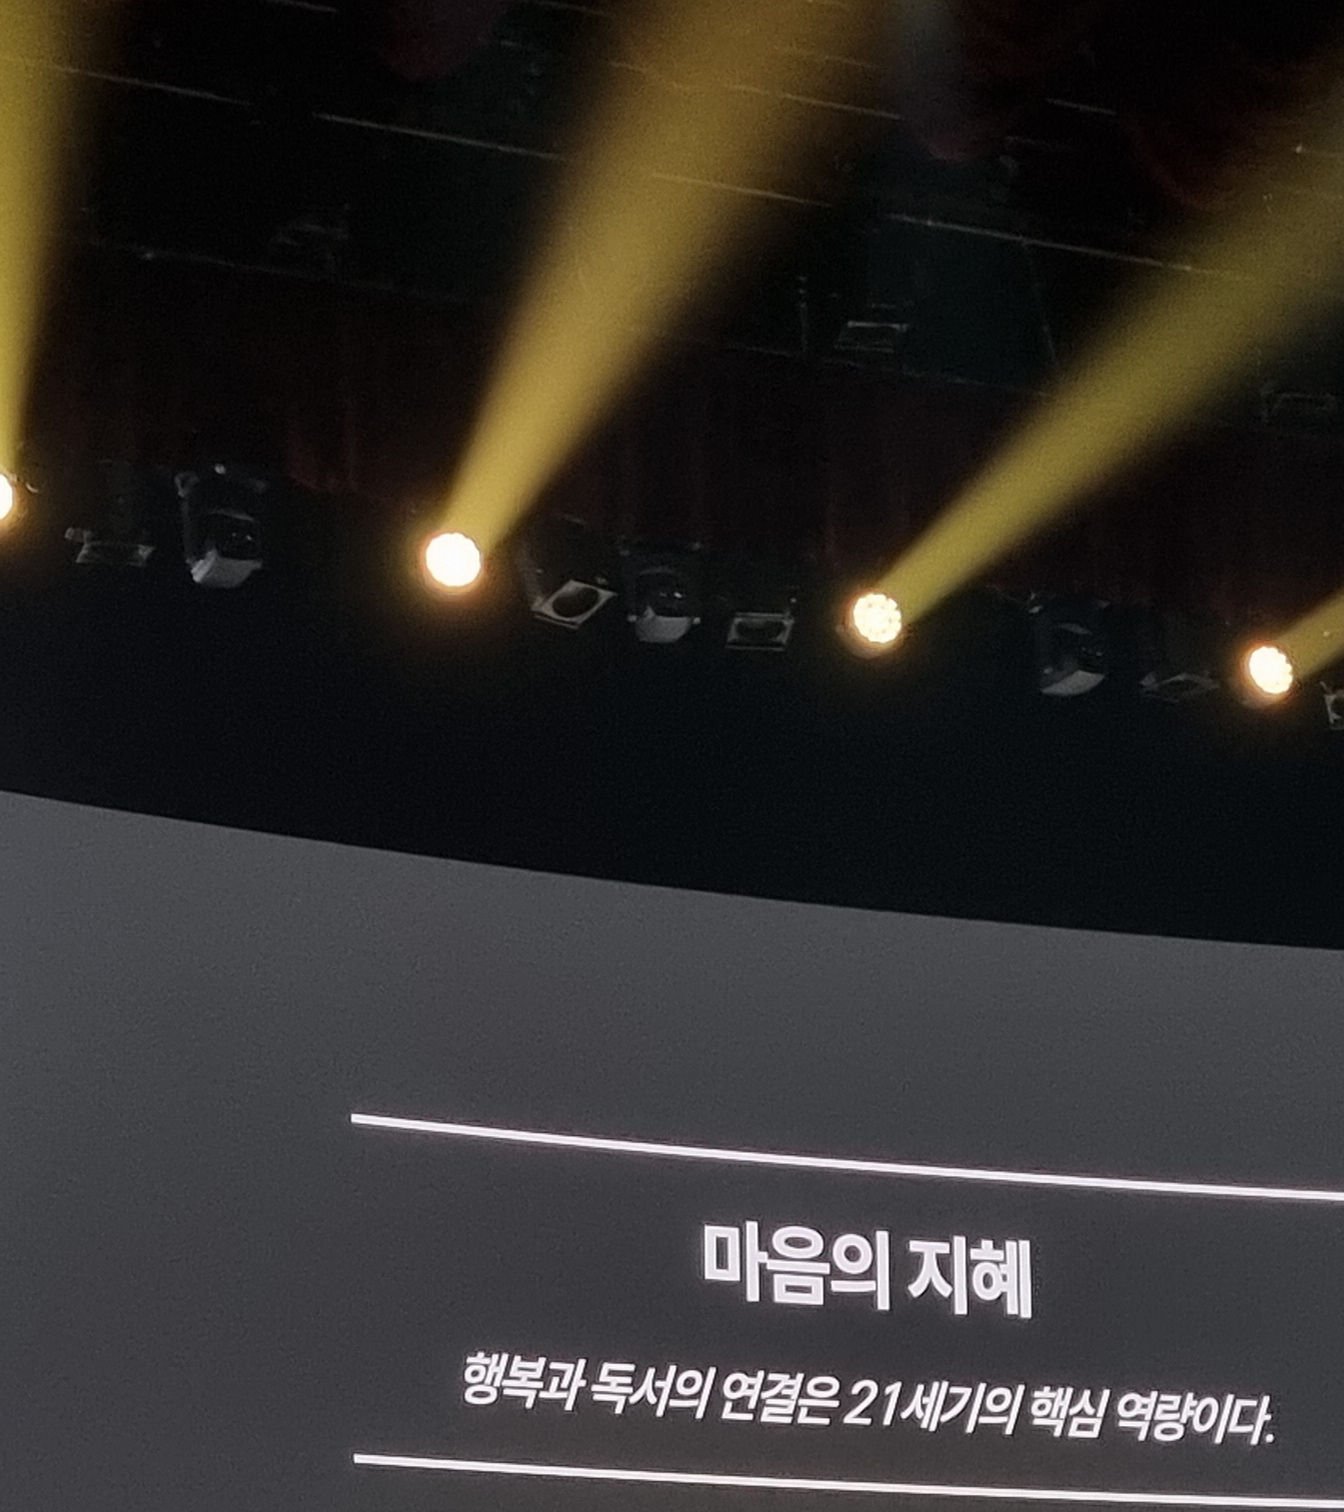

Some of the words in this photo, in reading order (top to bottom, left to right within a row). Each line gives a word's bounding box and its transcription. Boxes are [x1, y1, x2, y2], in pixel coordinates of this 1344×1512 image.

[702, 1219, 891, 1311] 마음의
[907, 1234, 1033, 1318] 지혜
[463, 1351, 587, 1412] 행복과
[591, 1362, 716, 1419] 독서의
[722, 1370, 840, 1425] 연결은
[843, 1379, 1025, 1435] 21세기의
[1031, 1385, 1111, 1438] 핵심
[1117, 1389, 1275, 1445] 역량이다.
